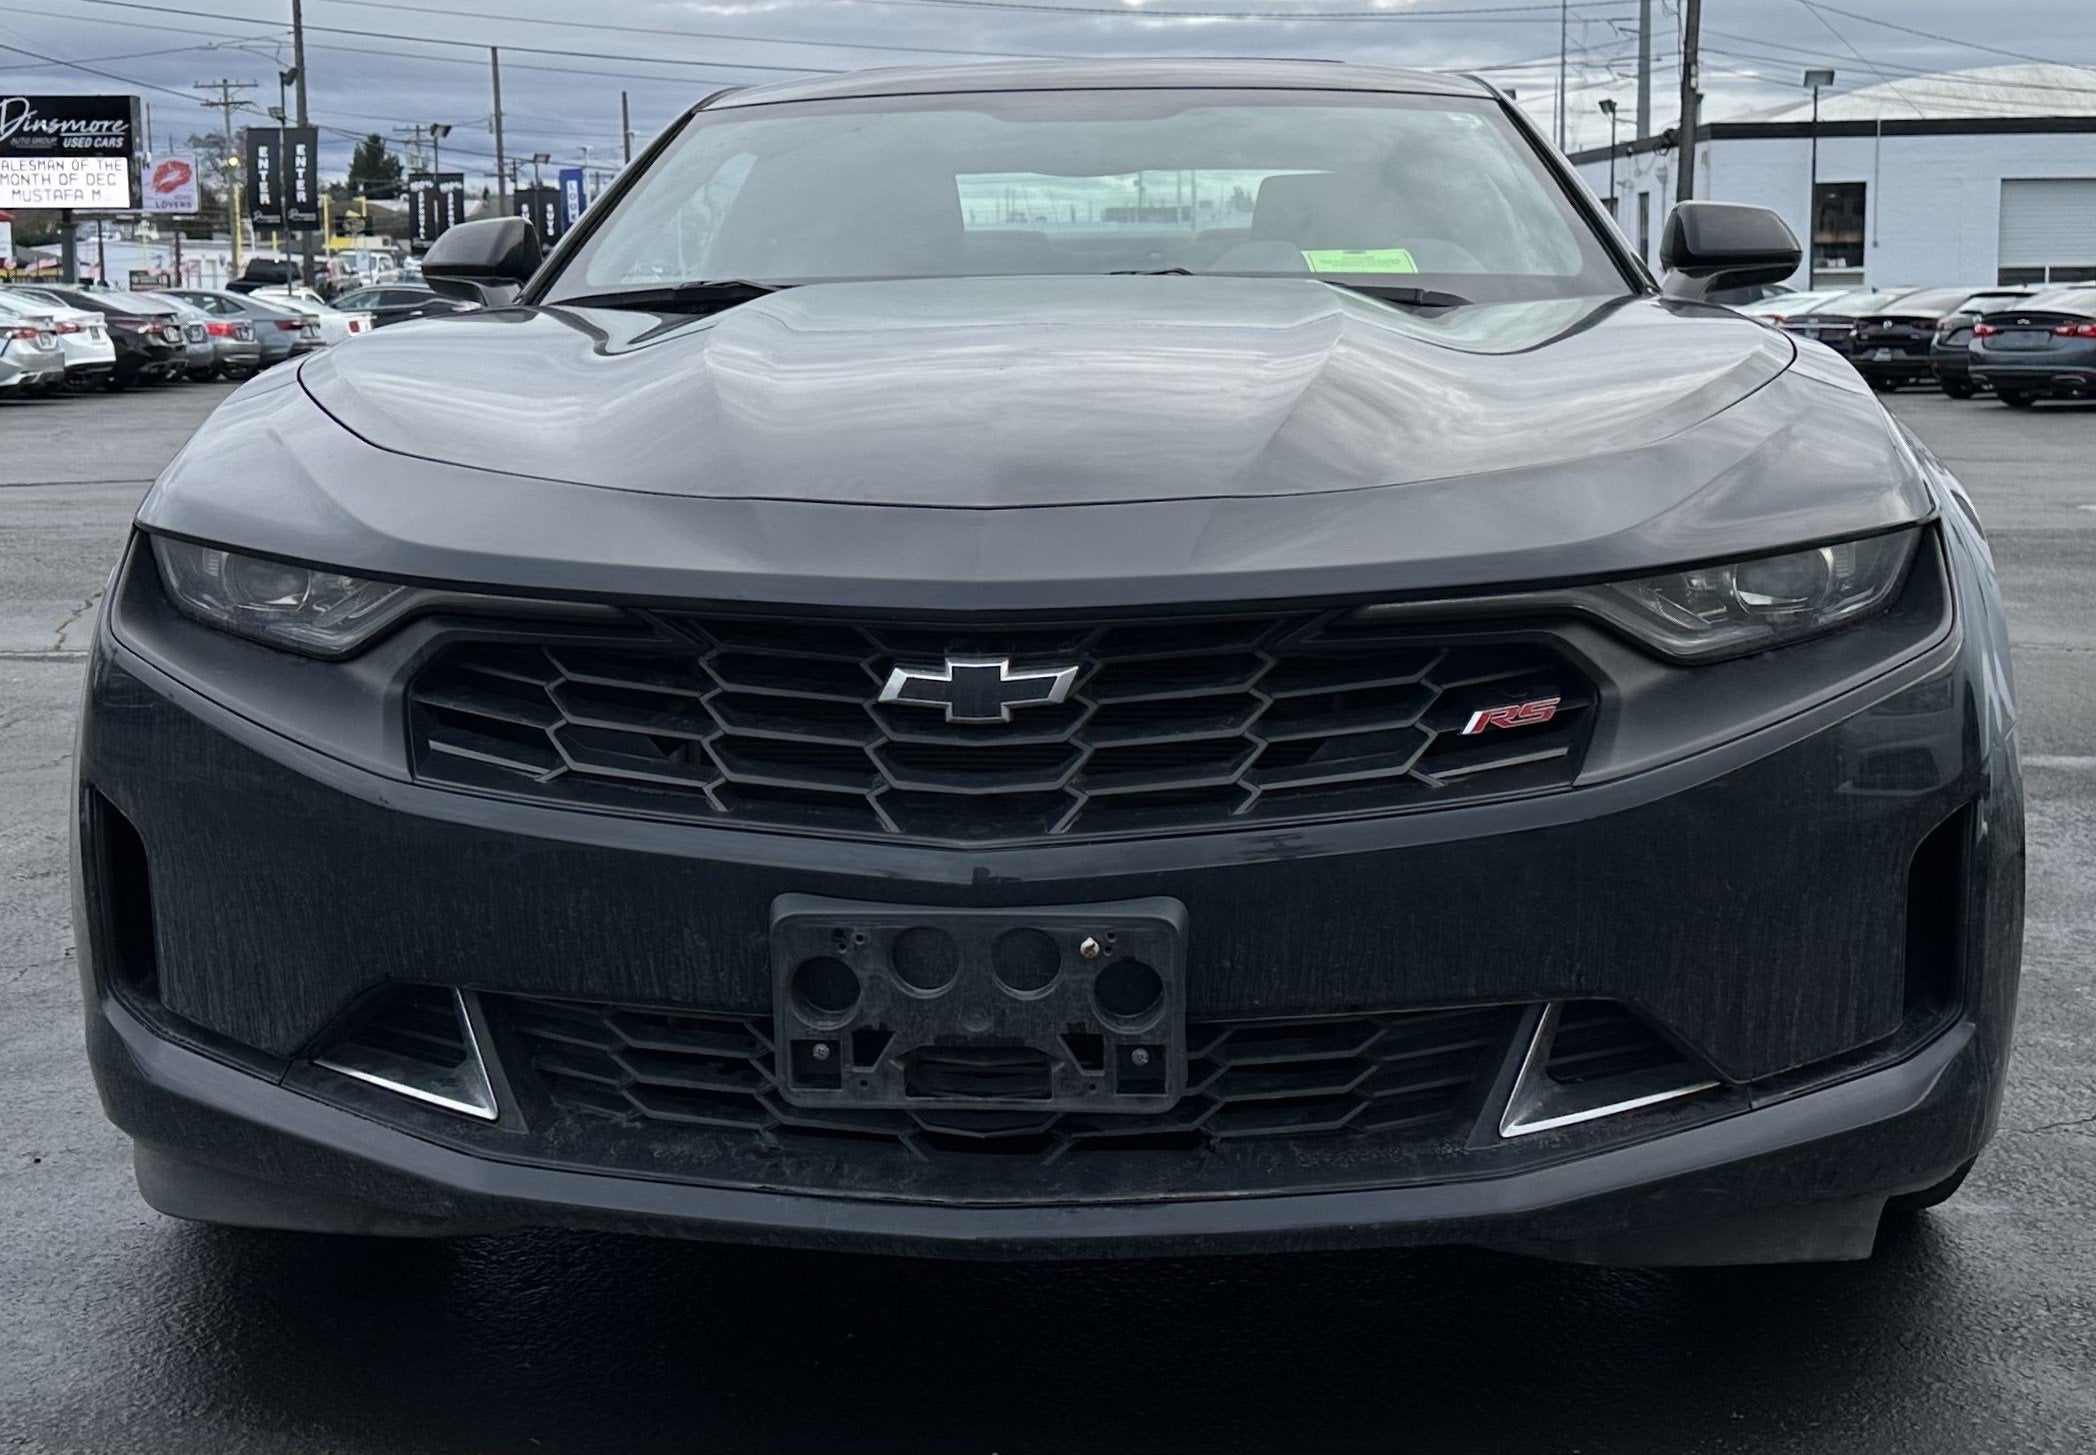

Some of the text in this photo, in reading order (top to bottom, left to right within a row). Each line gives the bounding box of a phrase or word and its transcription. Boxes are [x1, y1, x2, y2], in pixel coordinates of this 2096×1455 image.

[0, 97, 129, 141] Dinsmore
[63, 137, 124, 148] USED CARS
[0, 160, 122, 171] ALESMAN OF THE
[258, 145, 271, 205] ENTER
[294, 144, 307, 203] ENTER
[0, 173, 116, 186] MONTH OF DEC
[12, 189, 101, 202] MUSTAFA M
[155, 200, 192, 209] LOVERS
[569, 183, 577, 219] LOOK
[1461, 697, 1561, 735] RS
